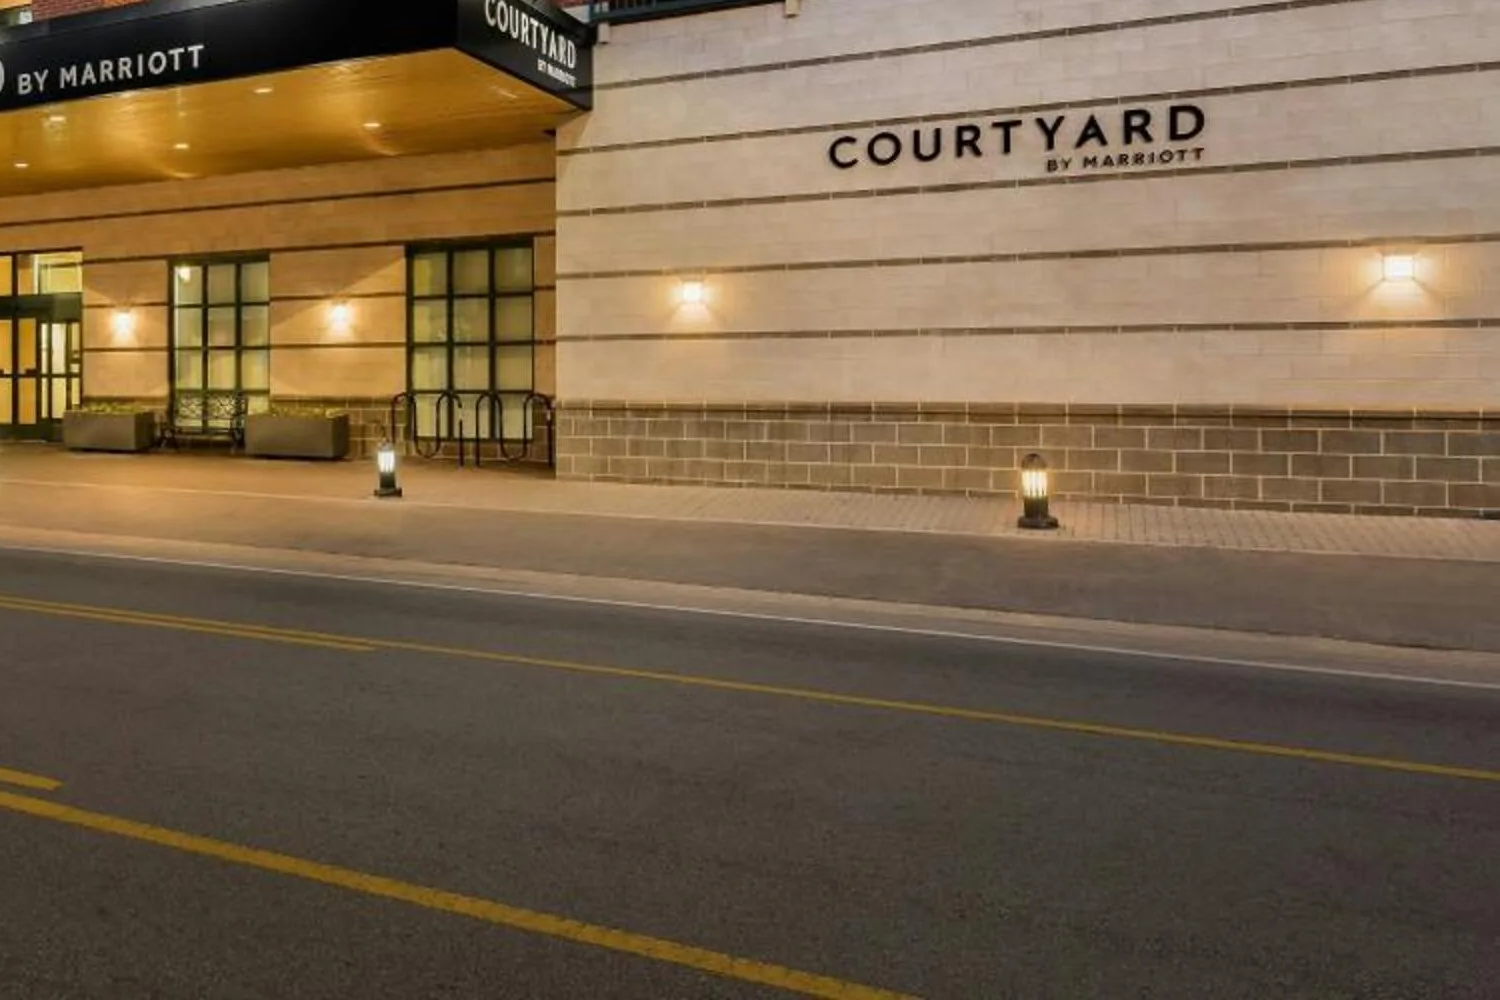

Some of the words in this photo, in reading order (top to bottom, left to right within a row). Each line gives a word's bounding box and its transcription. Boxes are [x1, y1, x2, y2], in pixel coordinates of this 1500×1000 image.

[17, 71, 48, 95] BY
[59, 45, 204, 88] MARRIOTT
[828, 105, 1206, 169] COURTYARD
[1047, 157, 1073, 172] BY
[1083, 147, 1205, 169] MARRIOTT
